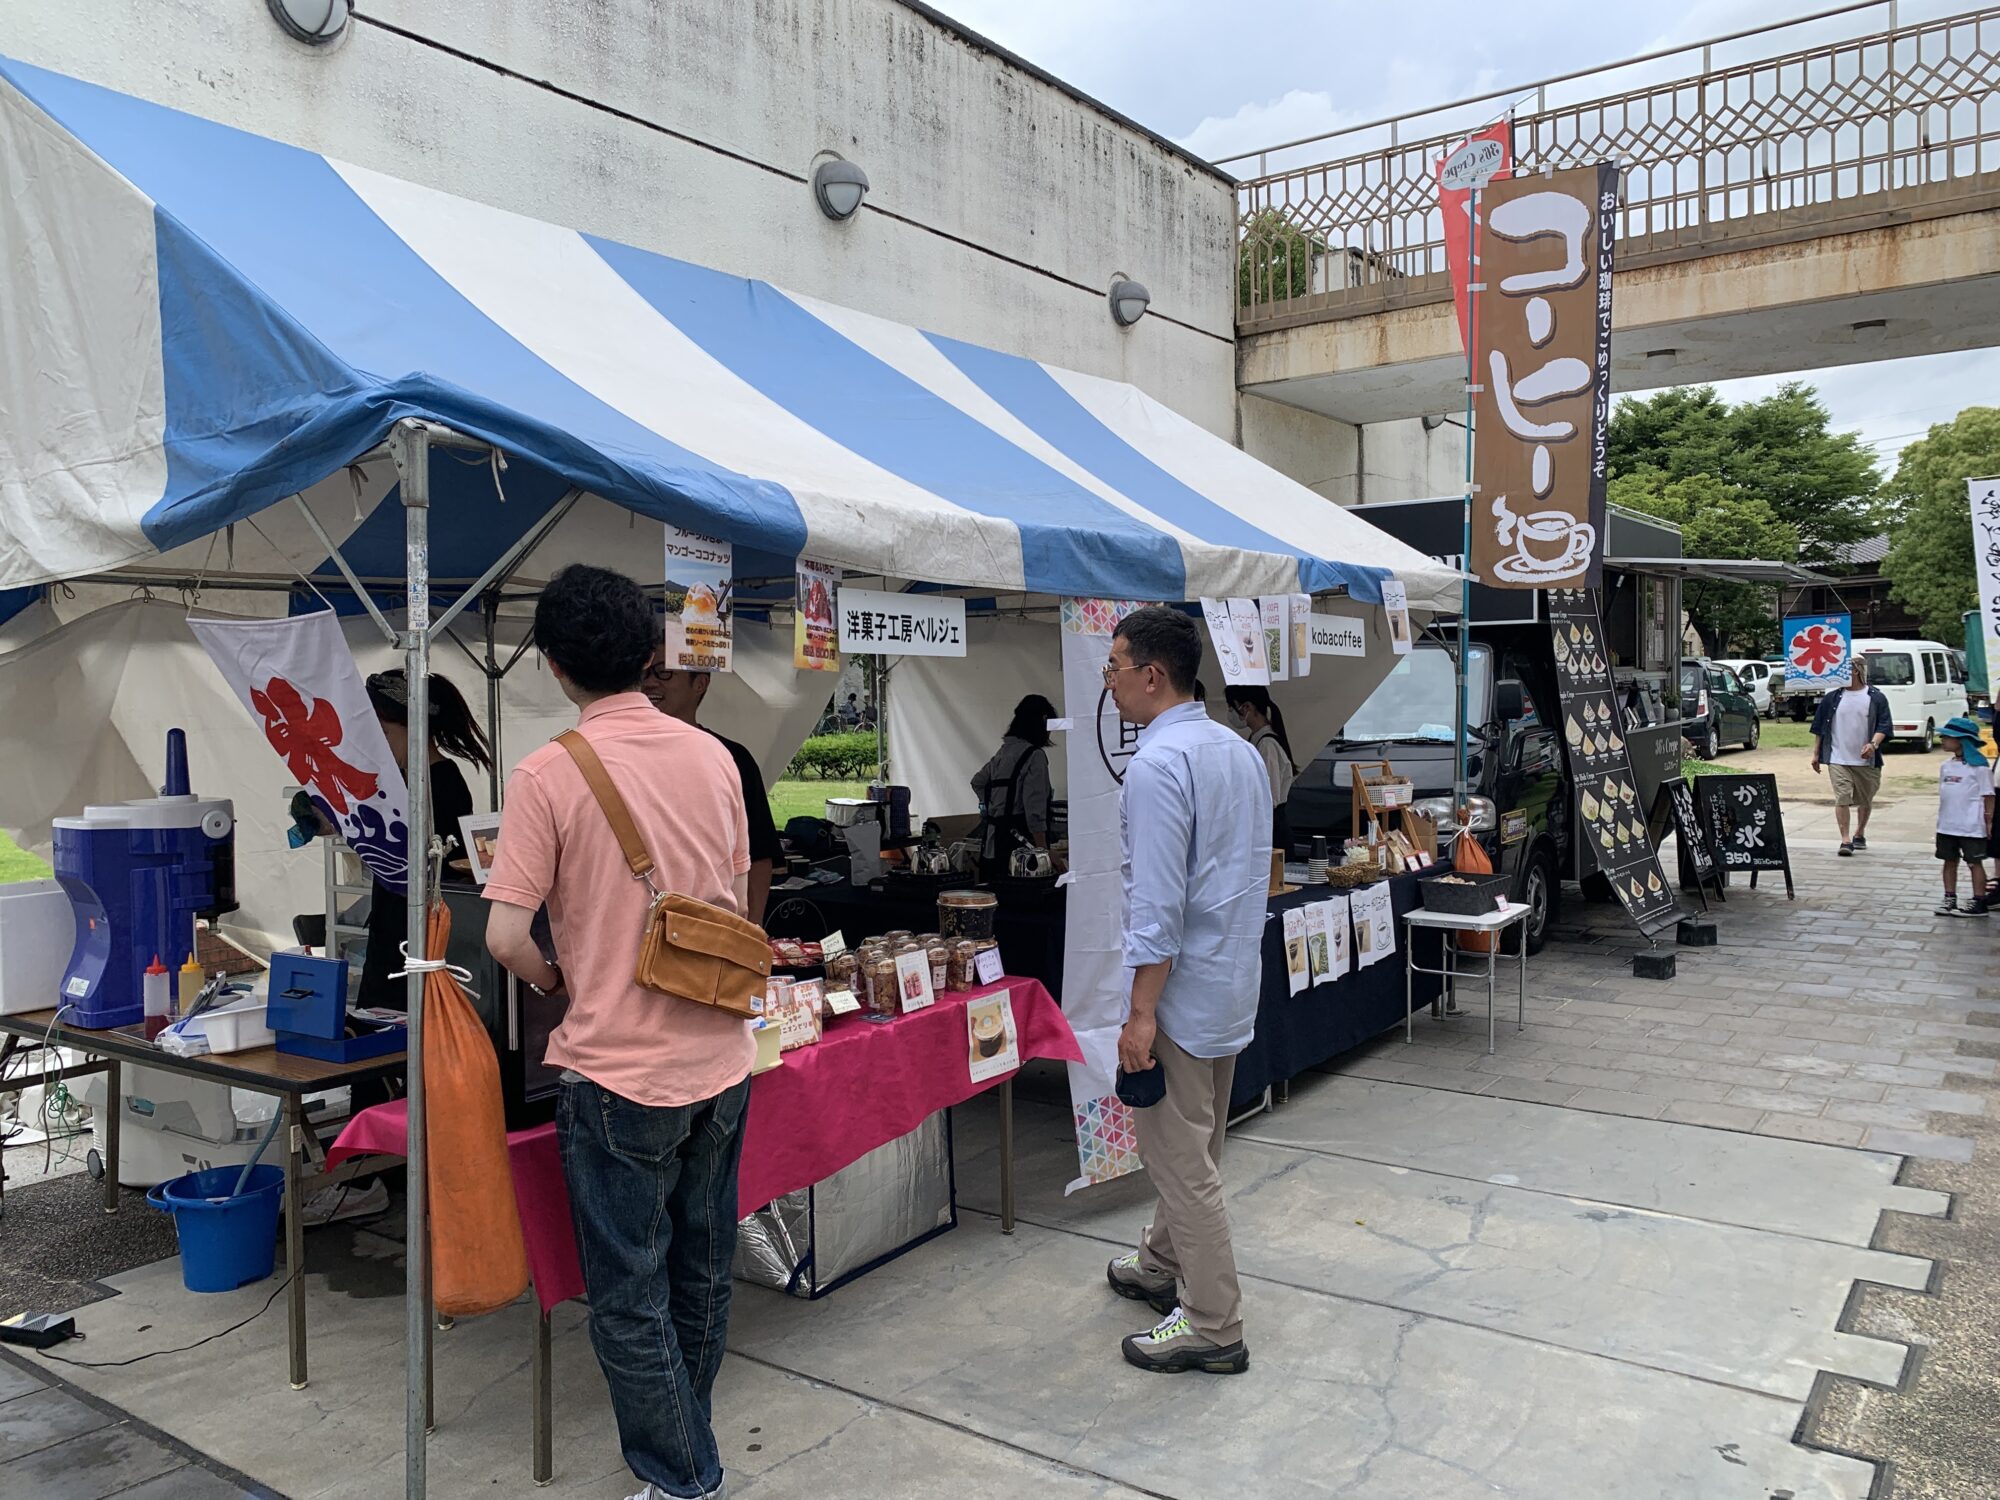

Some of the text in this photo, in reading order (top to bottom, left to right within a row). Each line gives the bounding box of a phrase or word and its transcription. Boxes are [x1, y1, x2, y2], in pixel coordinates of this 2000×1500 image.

[1489, 191, 1593, 497] コーヒー
[1592, 192, 1615, 479] おいしい珈琲でごゆっくりどうぞ
[666, 543, 731, 564] マンゴーココナッツ
[846, 609, 960, 644] 洋菓子工房ベルジェ
[1311, 627, 1363, 649] kobacoffee
[697, 655, 726, 669] 500円
[1732, 784, 1767, 848] かき氷
[1725, 852, 1752, 865] 350
